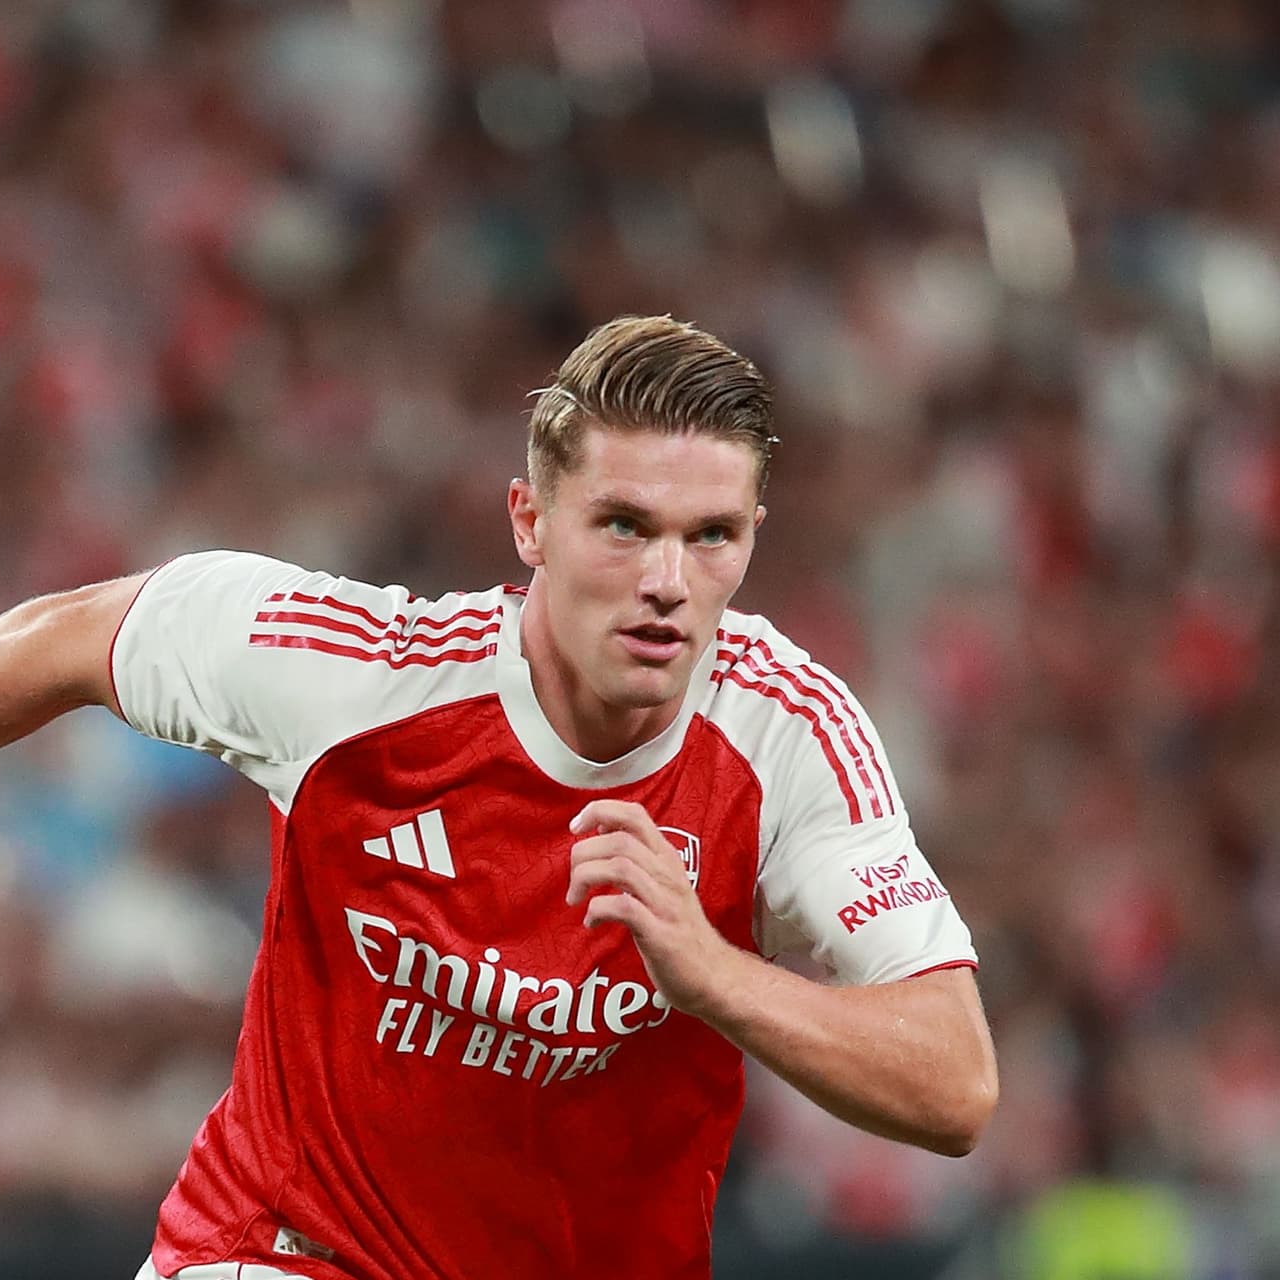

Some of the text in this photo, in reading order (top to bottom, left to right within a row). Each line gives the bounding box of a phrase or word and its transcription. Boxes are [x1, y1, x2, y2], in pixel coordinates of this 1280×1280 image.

[837, 878, 949, 934] RWANDA
[344, 907, 672, 1035] Emirates
[376, 998, 621, 1088] FLY BETTER
